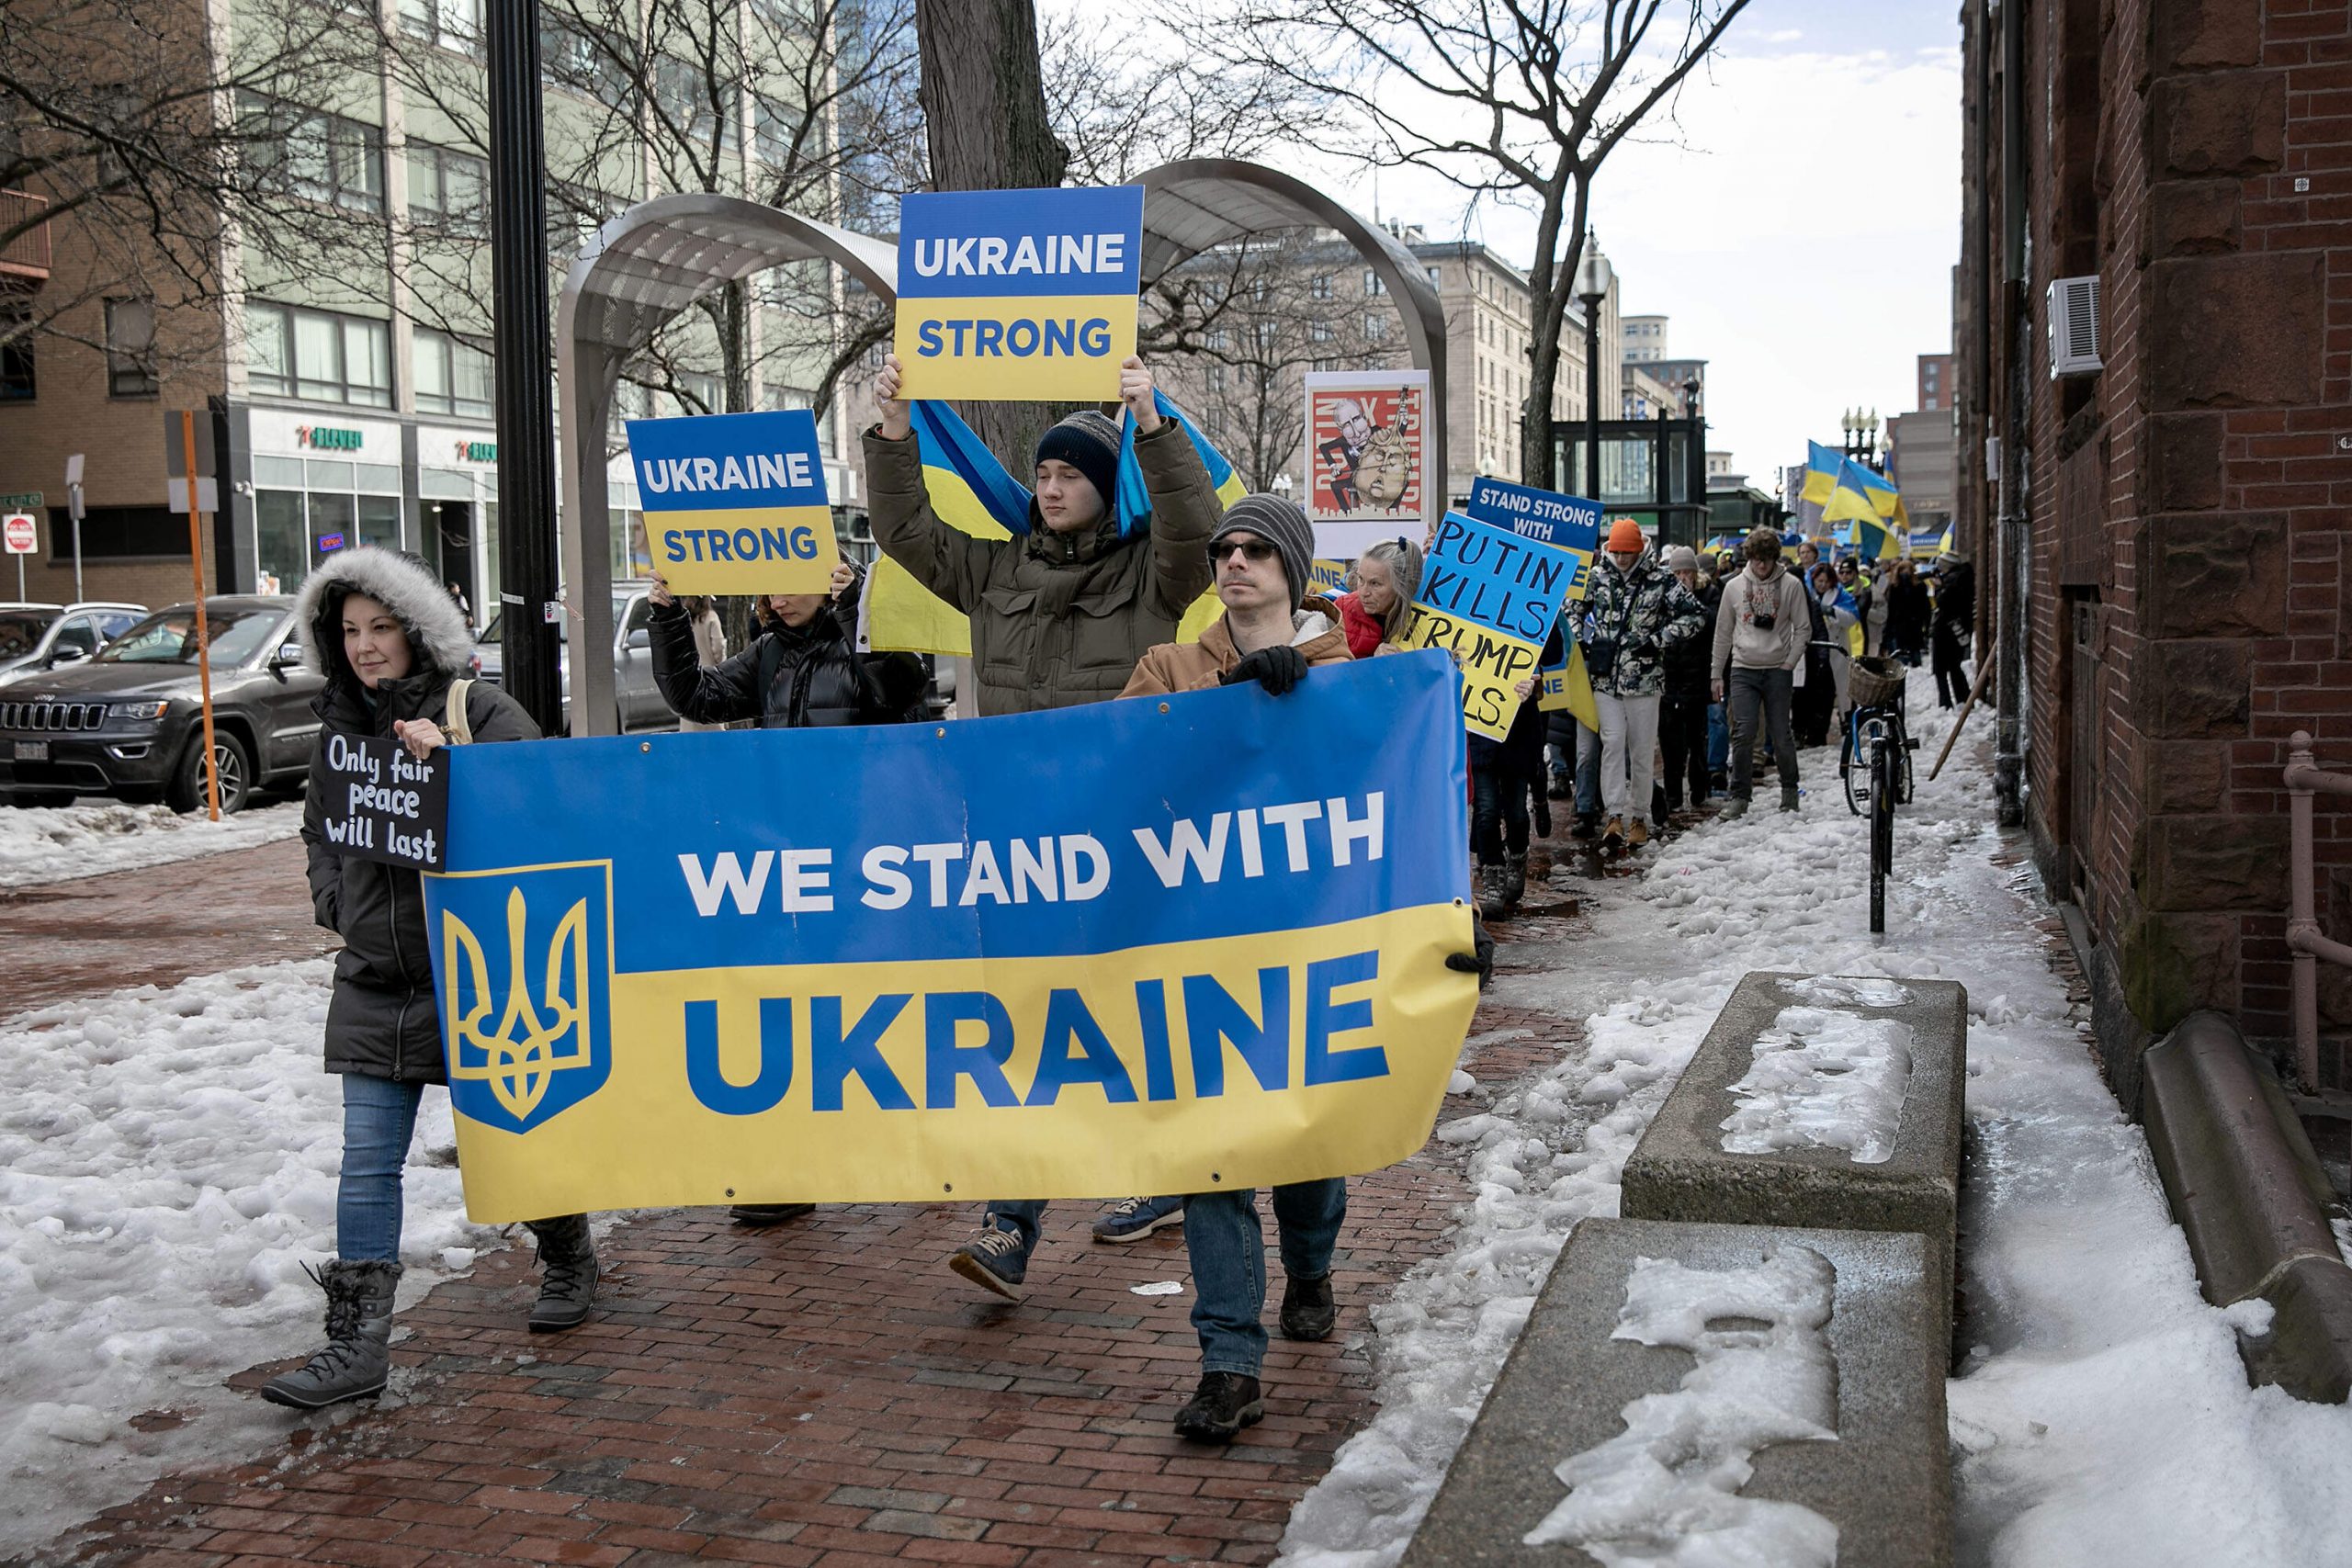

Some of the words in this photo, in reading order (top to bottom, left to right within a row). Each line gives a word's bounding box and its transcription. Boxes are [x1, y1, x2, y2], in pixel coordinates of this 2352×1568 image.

[914, 233, 1125, 277] UKRAINE
[917, 318, 1112, 357] STRONG
[643, 453, 813, 493] UKRAINE
[1479, 488, 1532, 513] STAND
[1533, 500, 1596, 527] STRONG
[1514, 517, 1554, 541] WITH
[663, 526, 819, 562] STRONG
[1433, 521, 1564, 594] PUTIN
[1403, 608, 1533, 681] TRUMP
[329, 735, 379, 784] Only
[390, 749, 434, 784] fair
[349, 783, 420, 818] peace
[325, 816, 374, 849] will
[388, 821, 437, 863] last
[680, 847, 834, 917] WE
[861, 832, 1112, 908] STAND
[1131, 791, 1385, 889] WITH
[684, 949, 1389, 1115] UKRAINE
